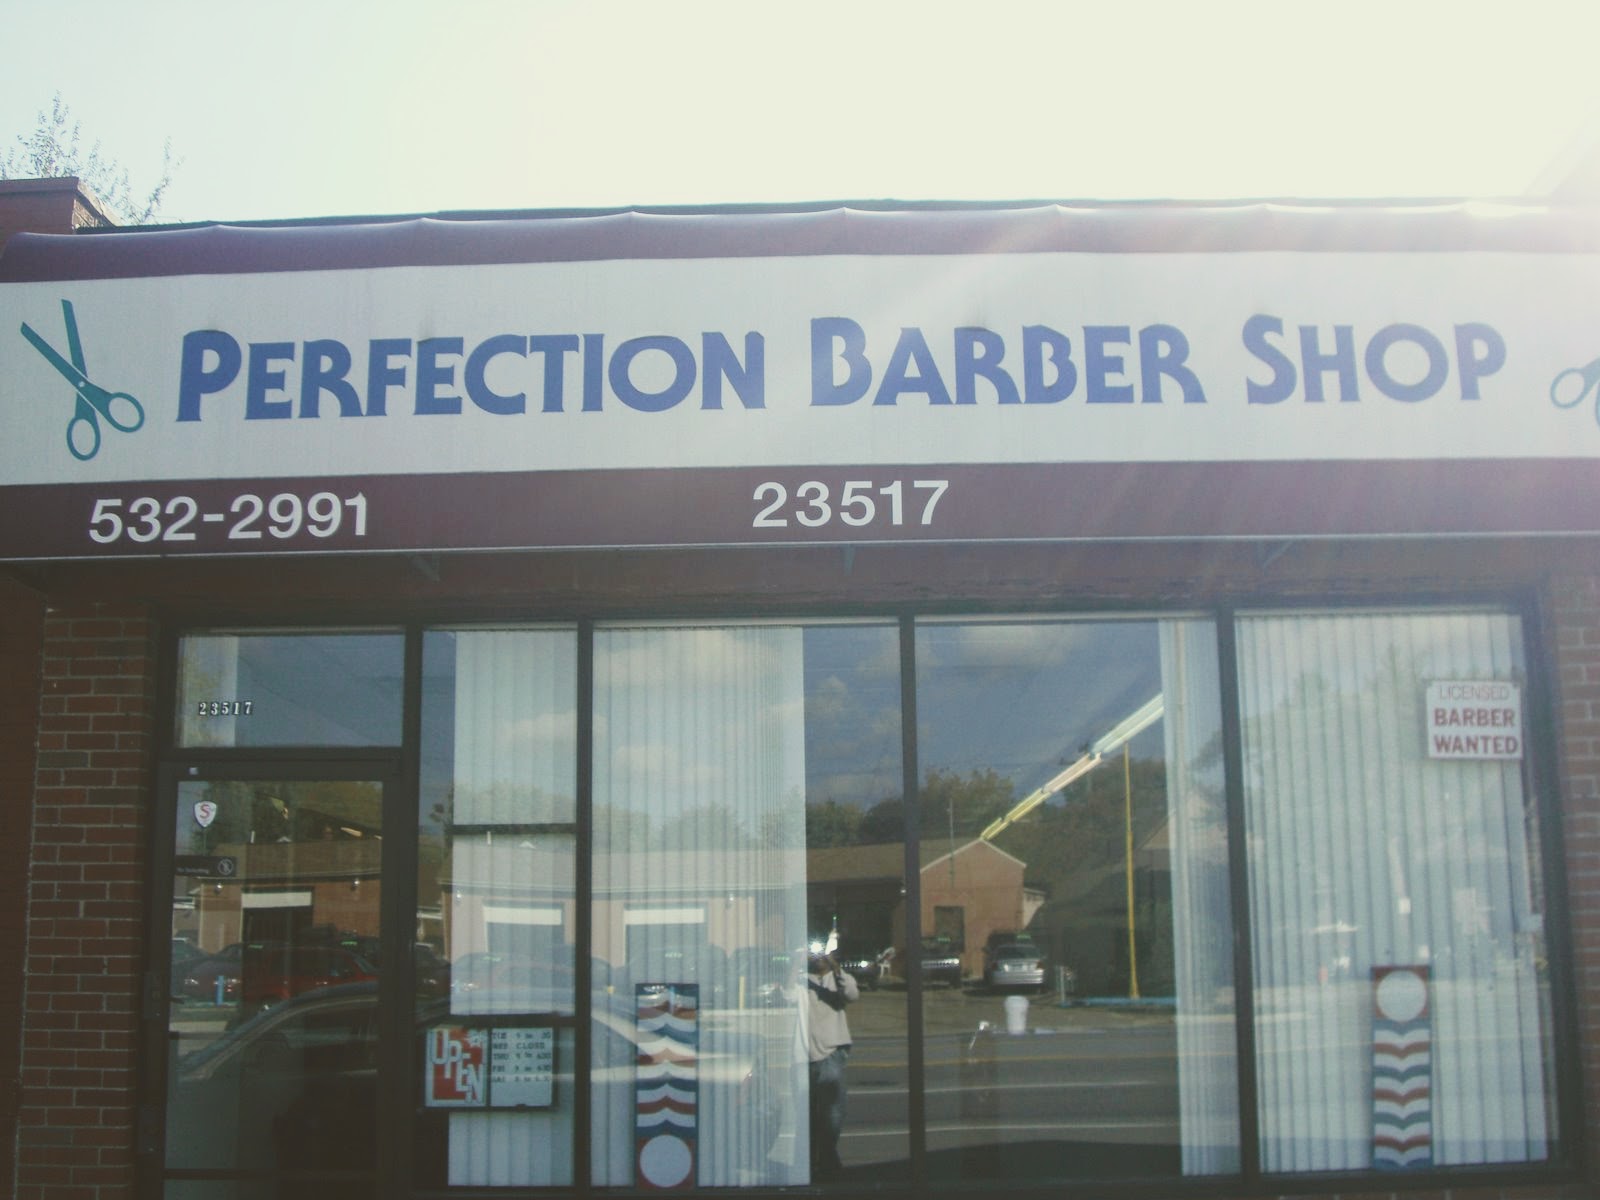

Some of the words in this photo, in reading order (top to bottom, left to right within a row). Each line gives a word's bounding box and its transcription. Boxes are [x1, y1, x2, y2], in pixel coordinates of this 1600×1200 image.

[175, 328, 766, 423] PERFECTION
[809, 317, 1207, 407] BARBER
[1242, 313, 1507, 406] SHOP
[751, 479, 950, 530] 23517
[88, 492, 369, 544] 532-2991
[1440, 684, 1511, 701] LICENSED
[199, 702, 254, 716] 23517
[1434, 707, 1516, 728] BARBER
[1433, 735, 1519, 755] WANTED
